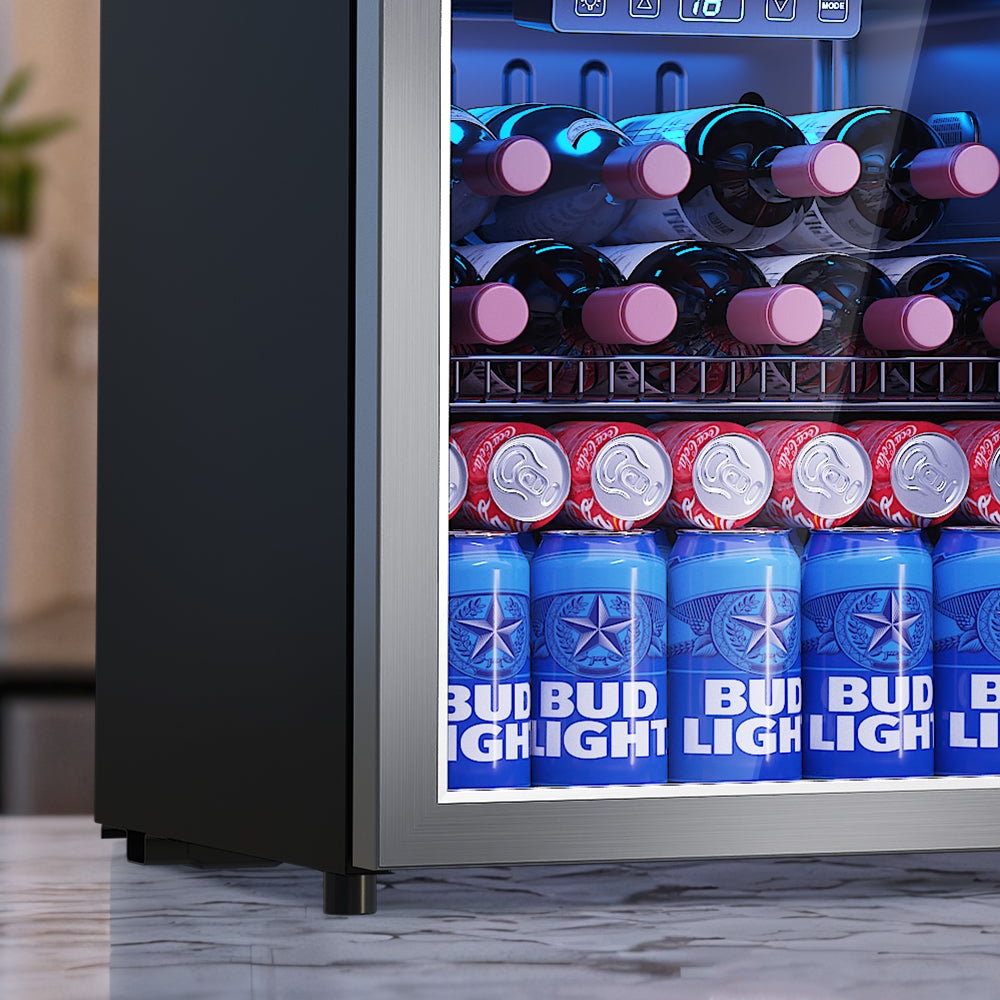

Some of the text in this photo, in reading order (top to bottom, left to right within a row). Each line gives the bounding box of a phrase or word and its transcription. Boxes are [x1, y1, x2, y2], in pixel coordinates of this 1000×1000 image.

[822, 1, 846, 10] MODE
[540, 681, 658, 719] BUD
[705, 677, 802, 716] BUD
[828, 675, 934, 713] BUD
[531, 719, 667, 760] LIGHT
[684, 716, 802, 756] LIGH
[810, 713, 935, 752] LIGH
